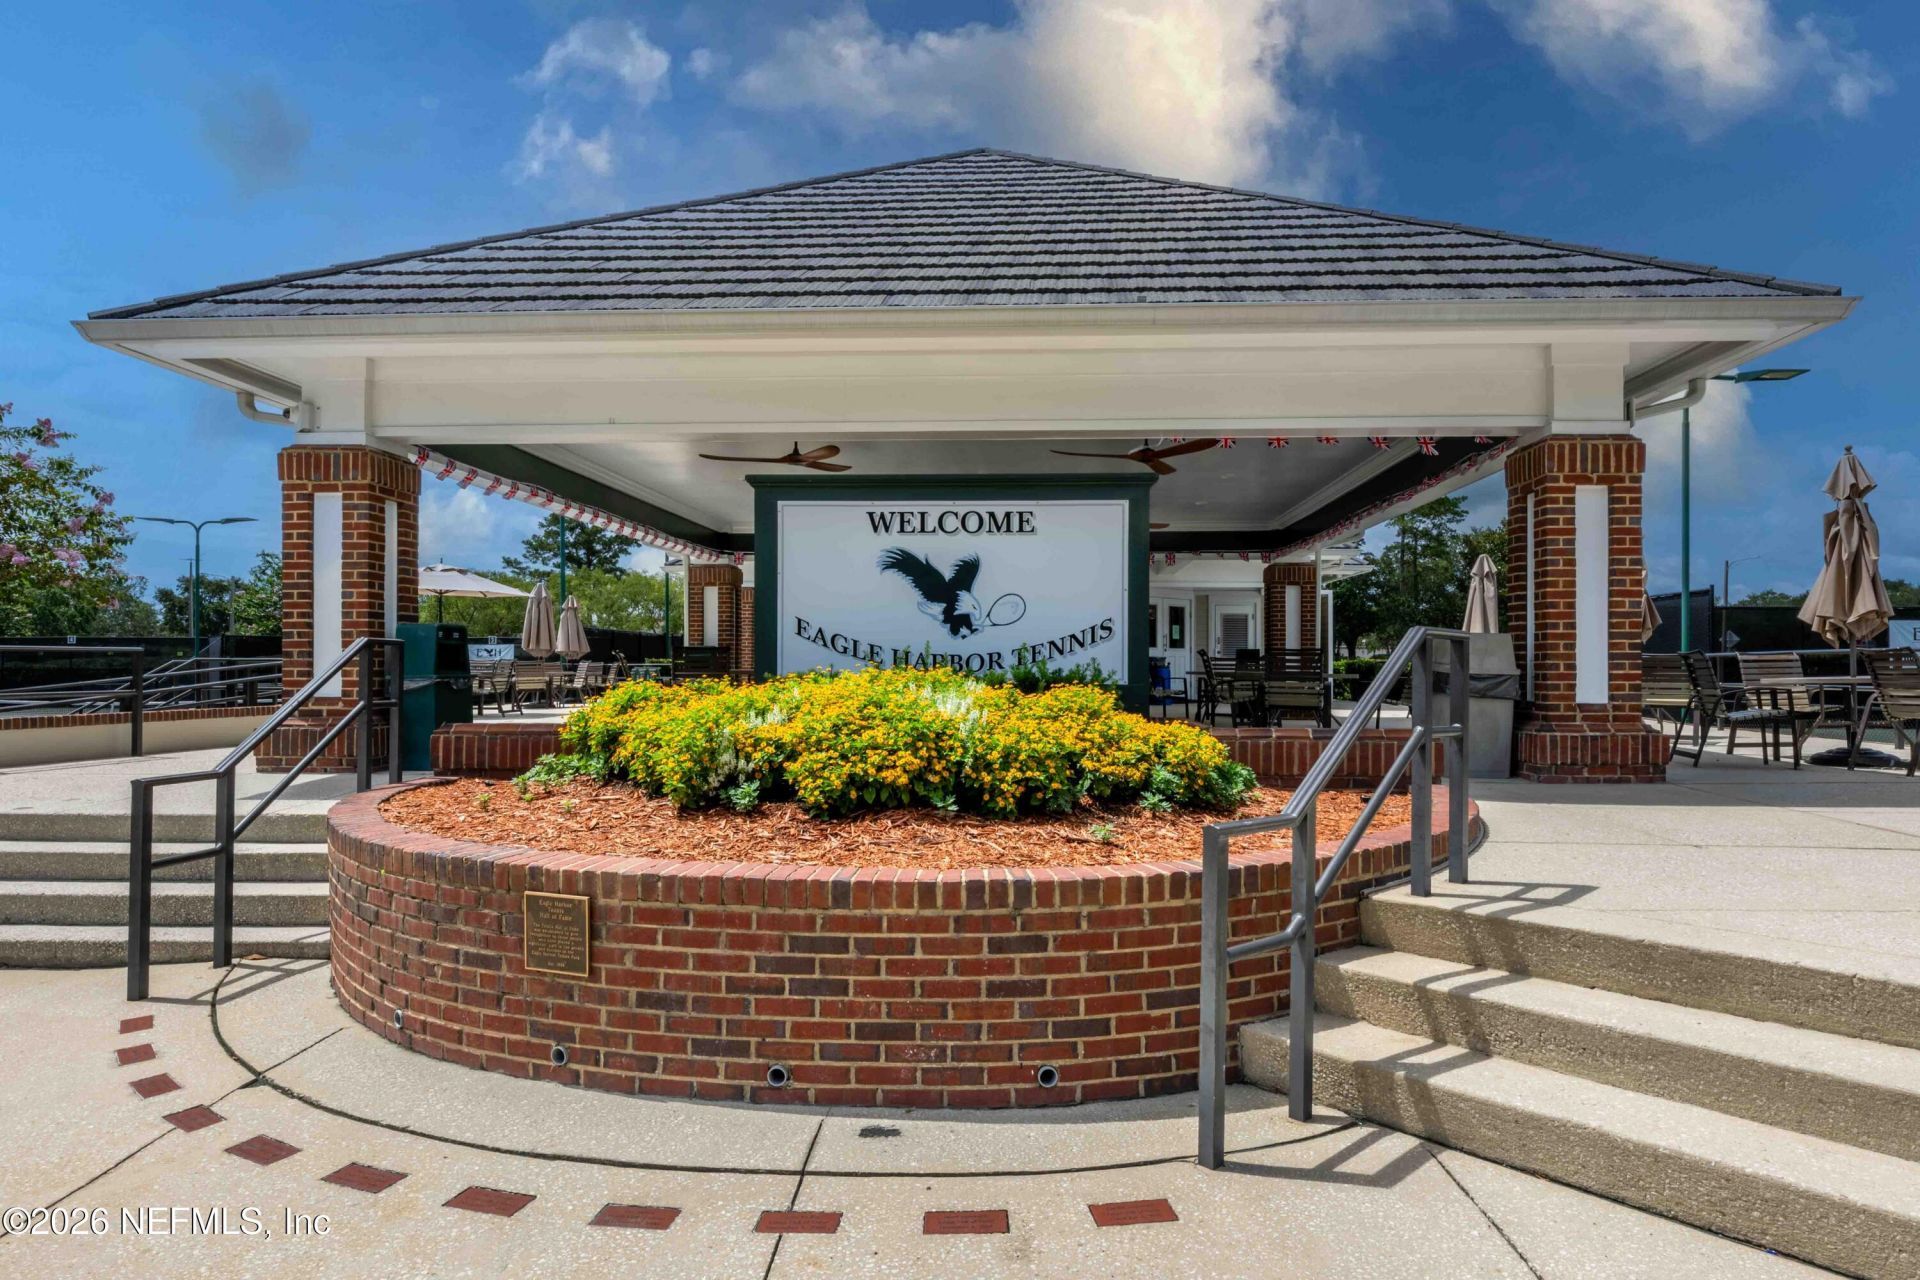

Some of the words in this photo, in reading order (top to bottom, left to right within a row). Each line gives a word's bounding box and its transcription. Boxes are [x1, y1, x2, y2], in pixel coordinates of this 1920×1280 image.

[866, 511, 1036, 535] WELCOME
[794, 616, 885, 665] EAGLE
[1011, 617, 1114, 666] TENNIS
